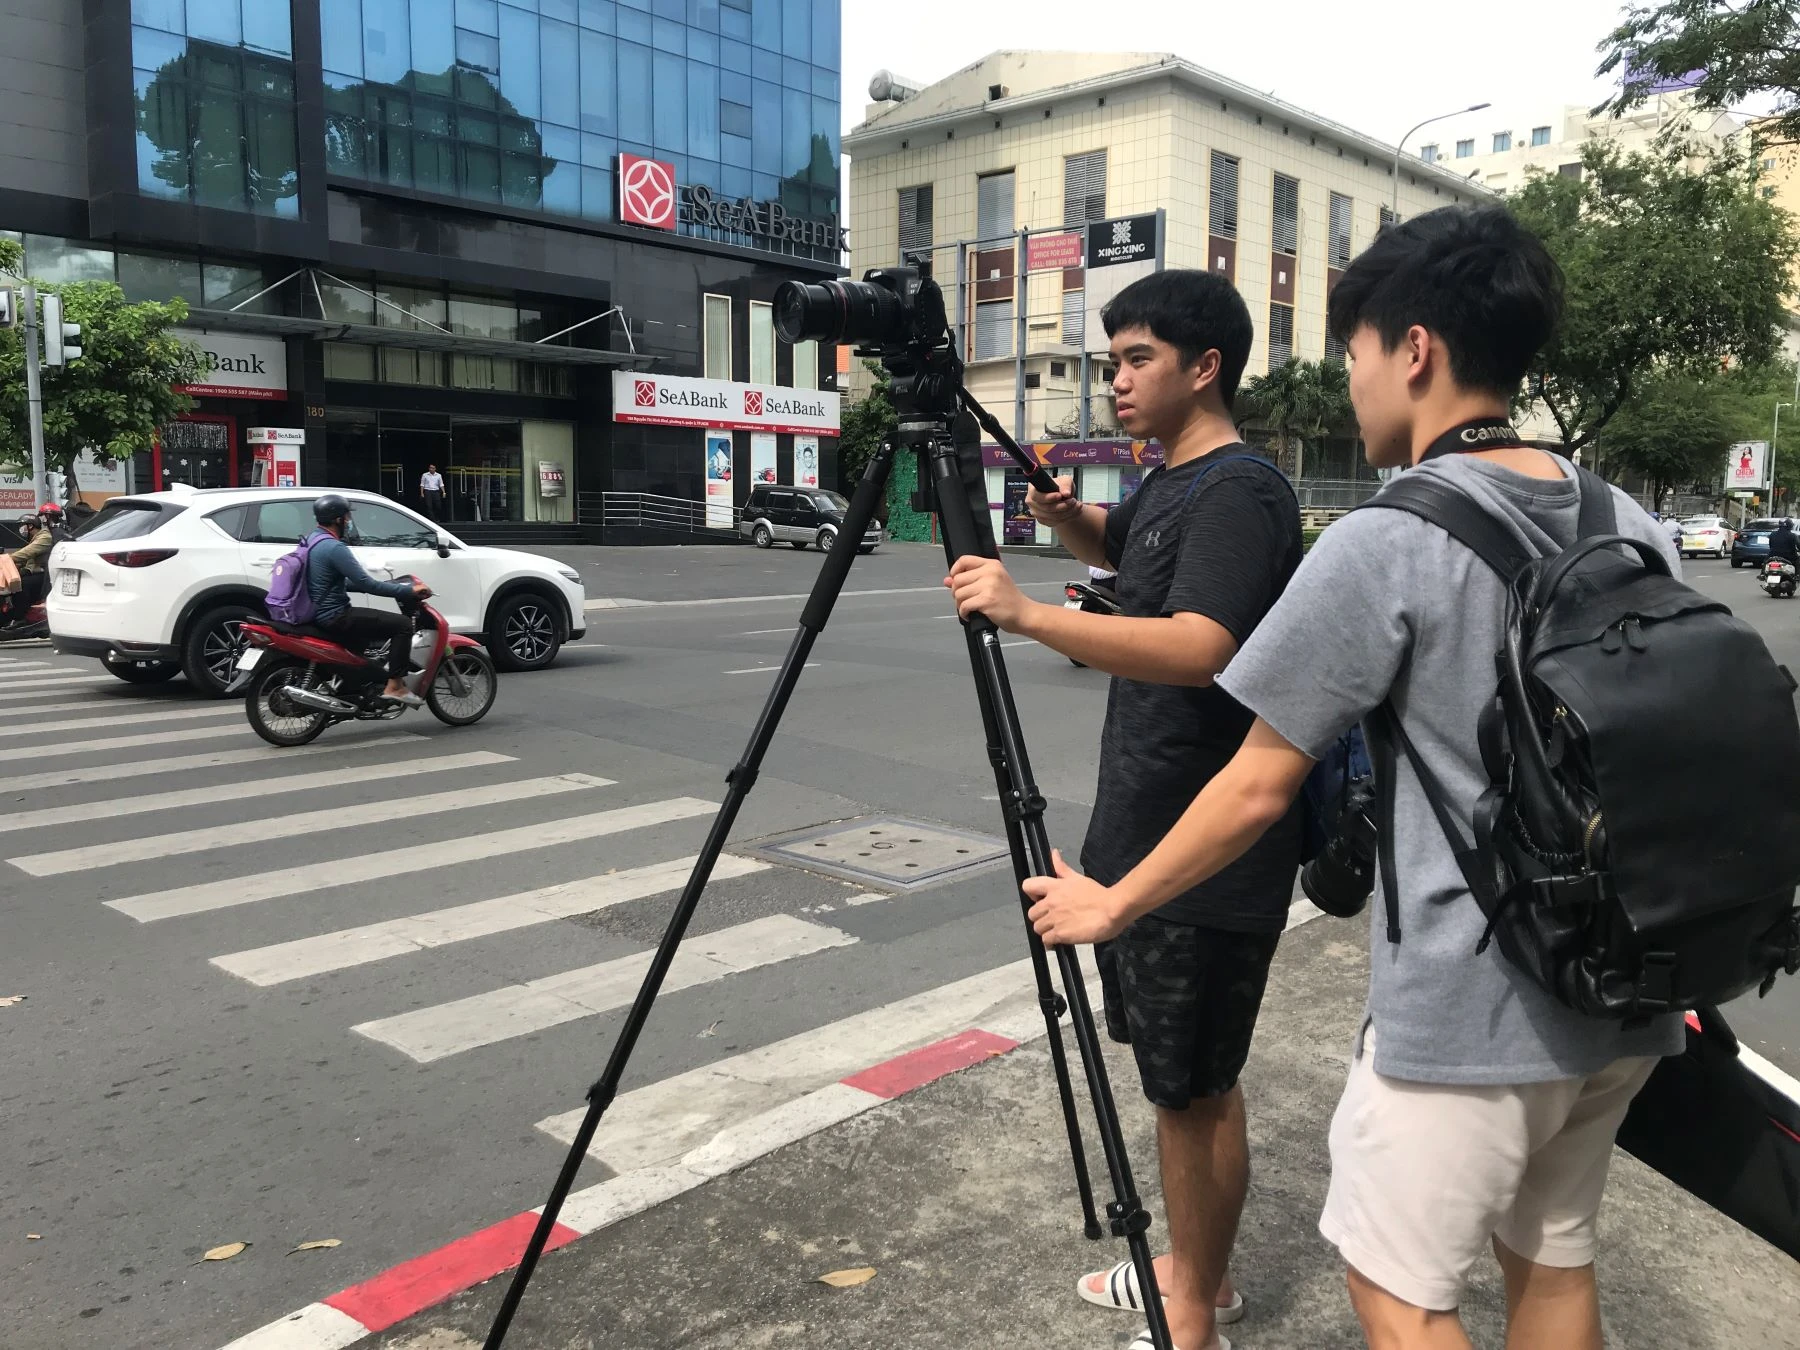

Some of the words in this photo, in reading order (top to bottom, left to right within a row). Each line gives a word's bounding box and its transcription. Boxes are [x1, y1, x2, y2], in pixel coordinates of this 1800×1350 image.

[691, 184, 852, 253] SeABank
[1060, 247, 1075, 256] LEASE
[1098, 246, 1121, 258] XING
[1122, 243, 1145, 254] XING
[659, 388, 728, 409] SeABank
[306, 406, 325, 417] 180
[765, 397, 826, 417] SeABank
[1460, 426, 1516, 443] Canon
[0, 491, 33, 500] SEALADY
